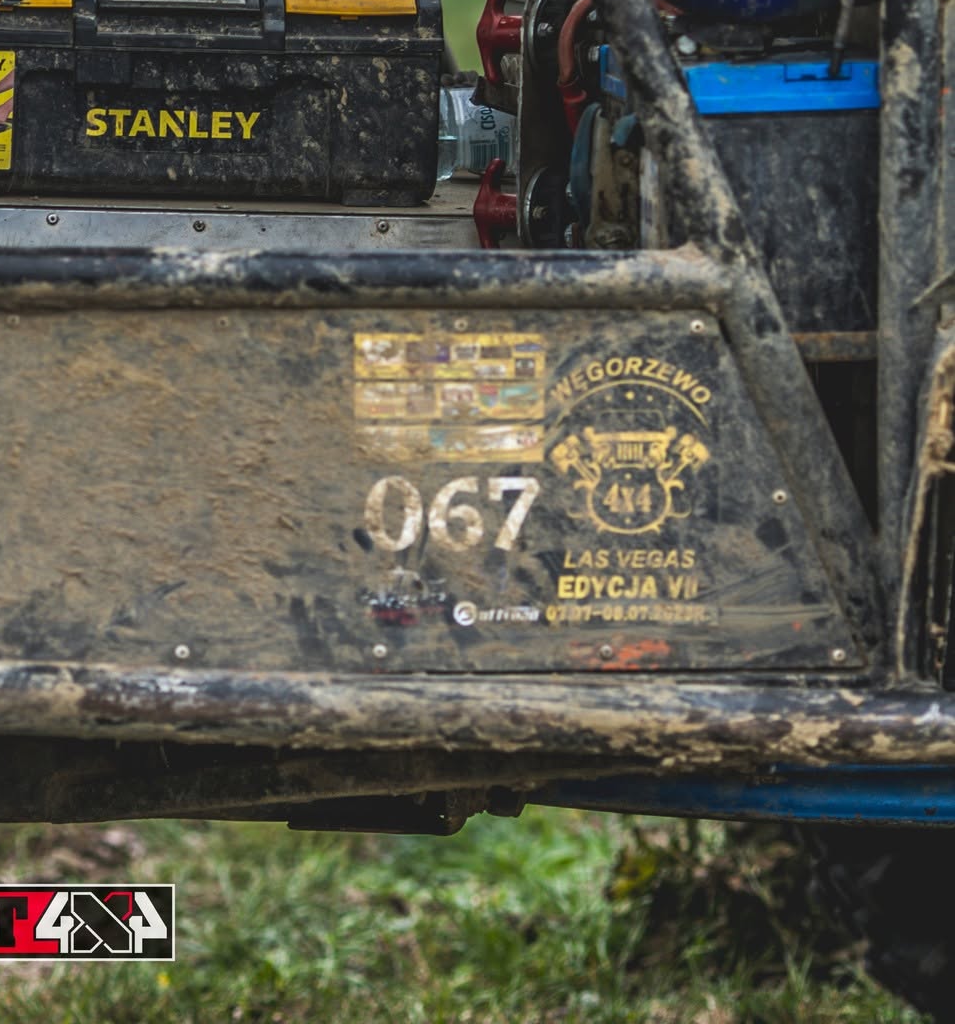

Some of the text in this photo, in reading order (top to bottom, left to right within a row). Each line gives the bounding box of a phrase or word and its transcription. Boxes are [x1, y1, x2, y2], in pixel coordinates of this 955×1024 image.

[86, 108, 260, 140] STANLEY
[364, 476, 540, 552] 067
[563, 549, 695, 569] LAS VEGAS
[557, 576, 657, 599] EDYCJA
